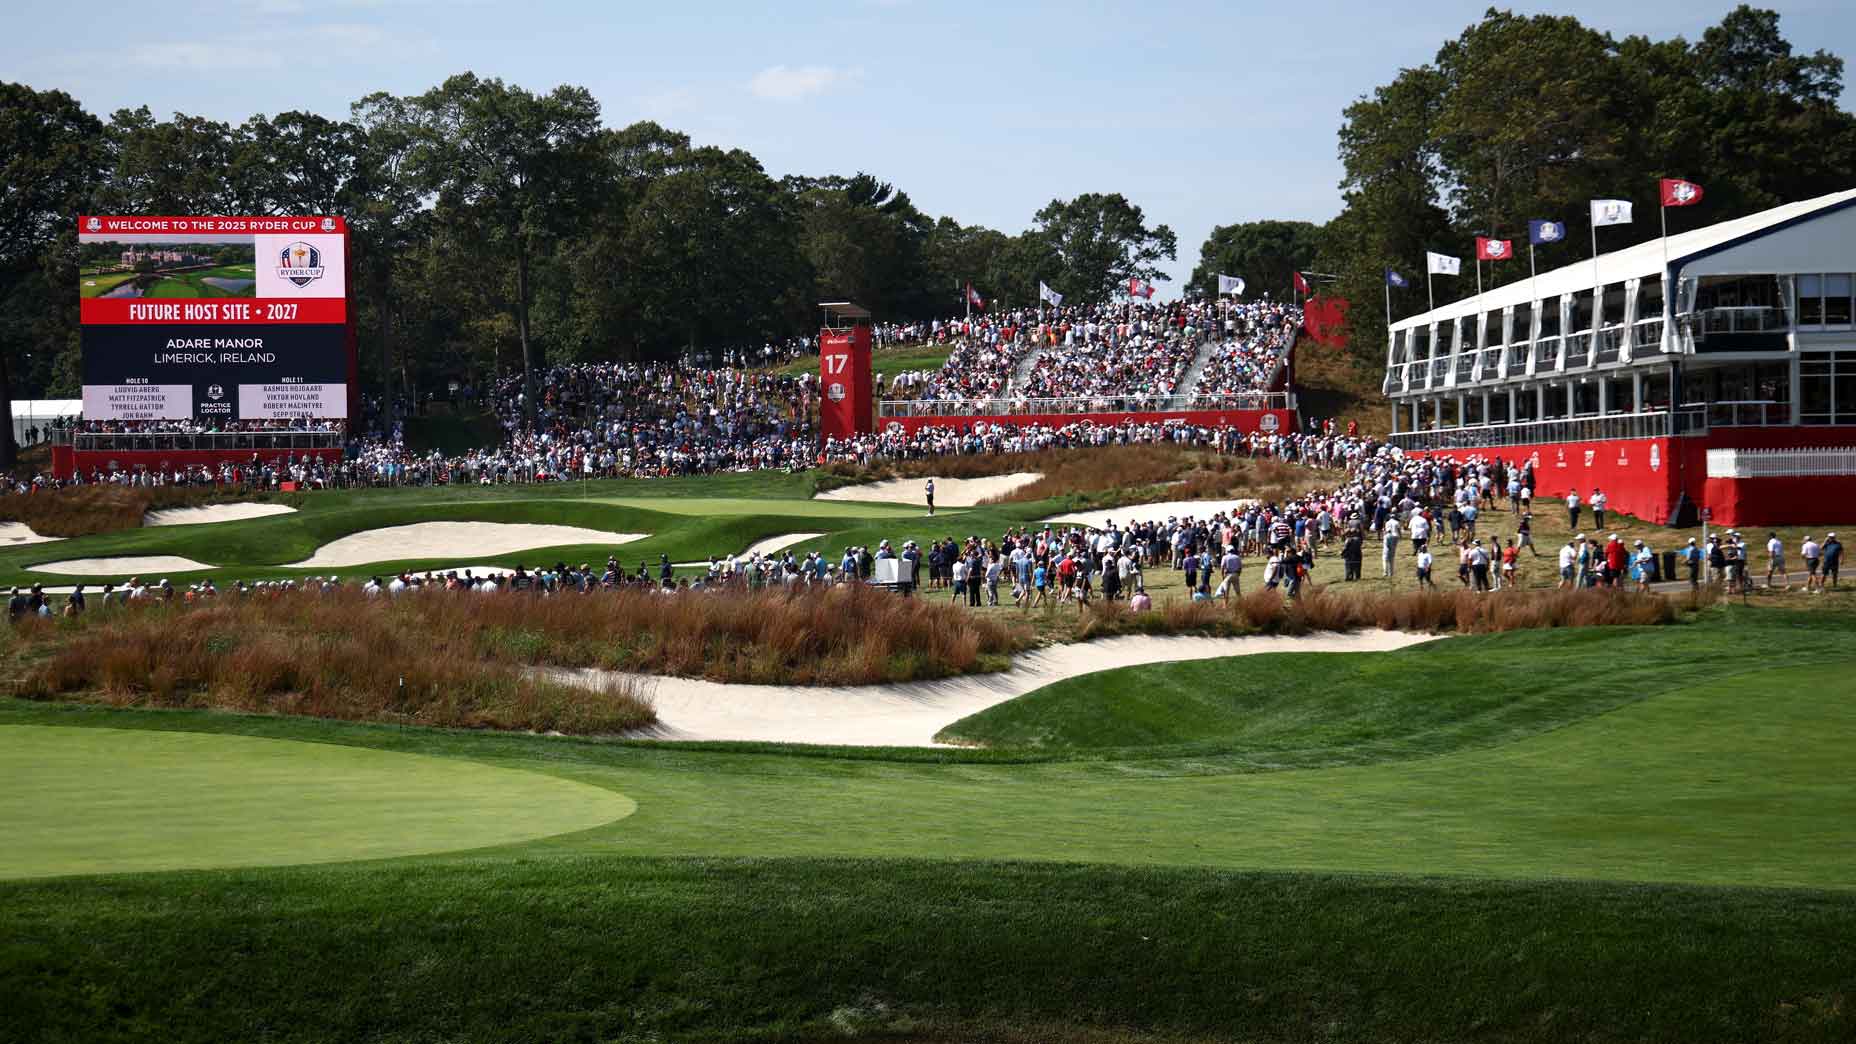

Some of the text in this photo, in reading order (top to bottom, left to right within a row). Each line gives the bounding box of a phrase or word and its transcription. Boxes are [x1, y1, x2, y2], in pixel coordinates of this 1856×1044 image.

[108, 221, 317, 230] WELCOME TO THE 2025 RYDER CUP
[129, 303, 298, 320] FUTURE HOST SITE 2027
[166, 338, 263, 349] ADARE MANOR
[154, 352, 276, 364] LIMERICK, IRELAND
[825, 354, 848, 374] 17
[111, 403, 164, 411] TYRRELL HATTON
